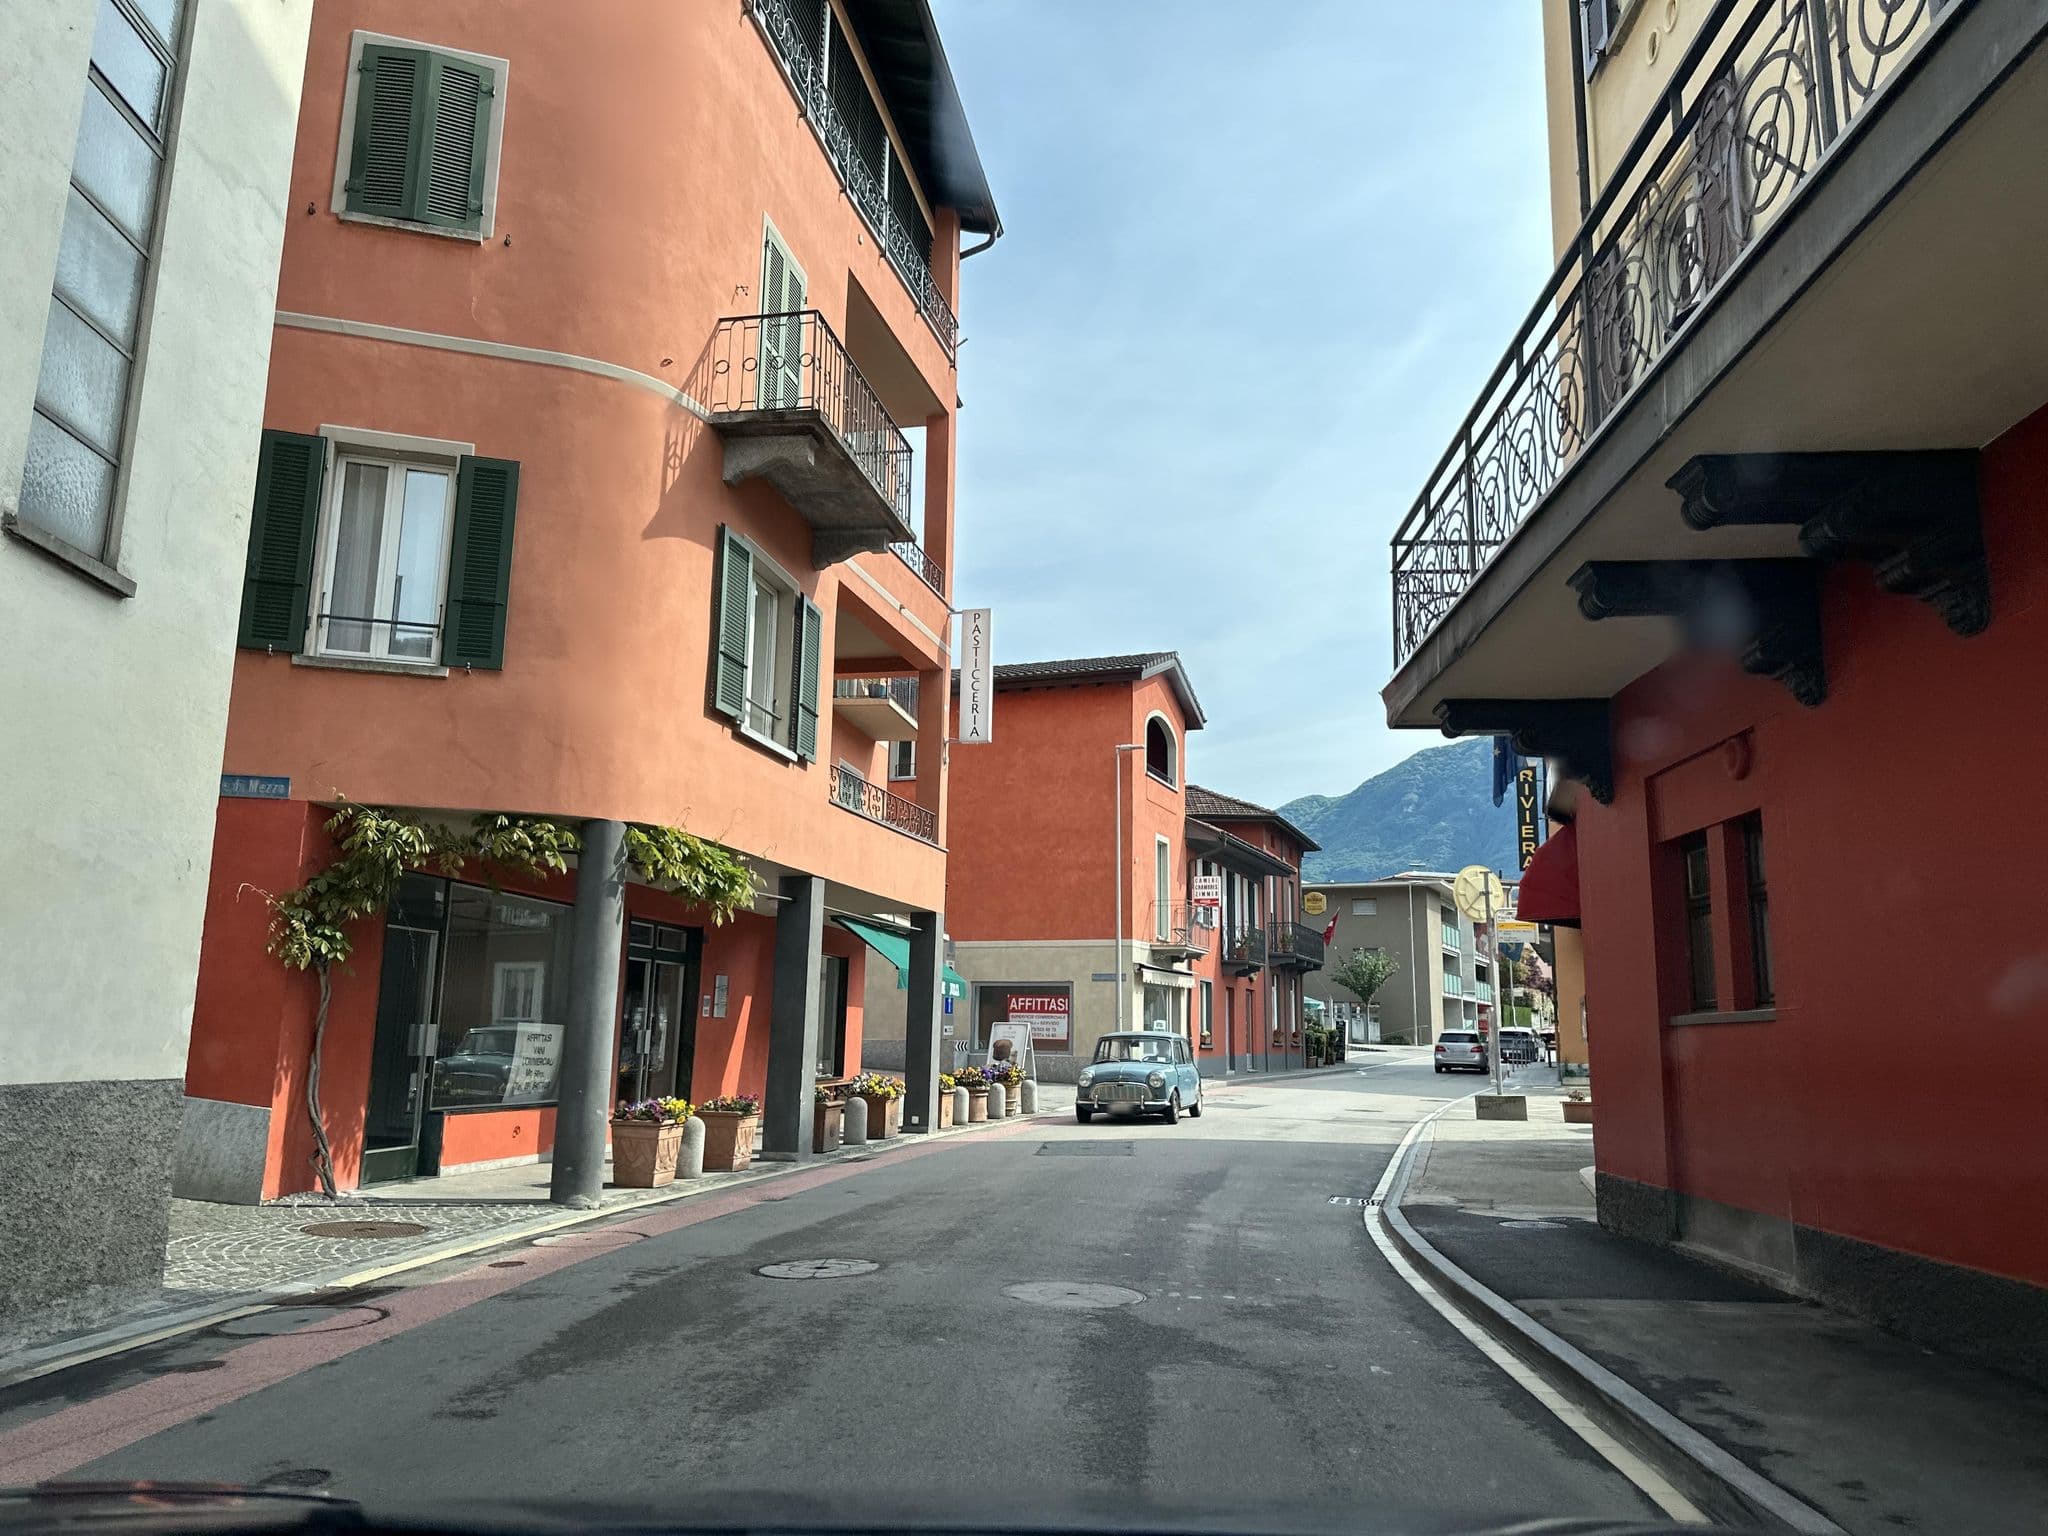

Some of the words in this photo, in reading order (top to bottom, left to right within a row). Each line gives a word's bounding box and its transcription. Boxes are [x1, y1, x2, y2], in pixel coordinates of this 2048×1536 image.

[970, 613, 981, 737] PASTICCERIA
[1520, 769, 1536, 869] RIVIERA
[1009, 997, 1069, 1011] AFFITTASI
